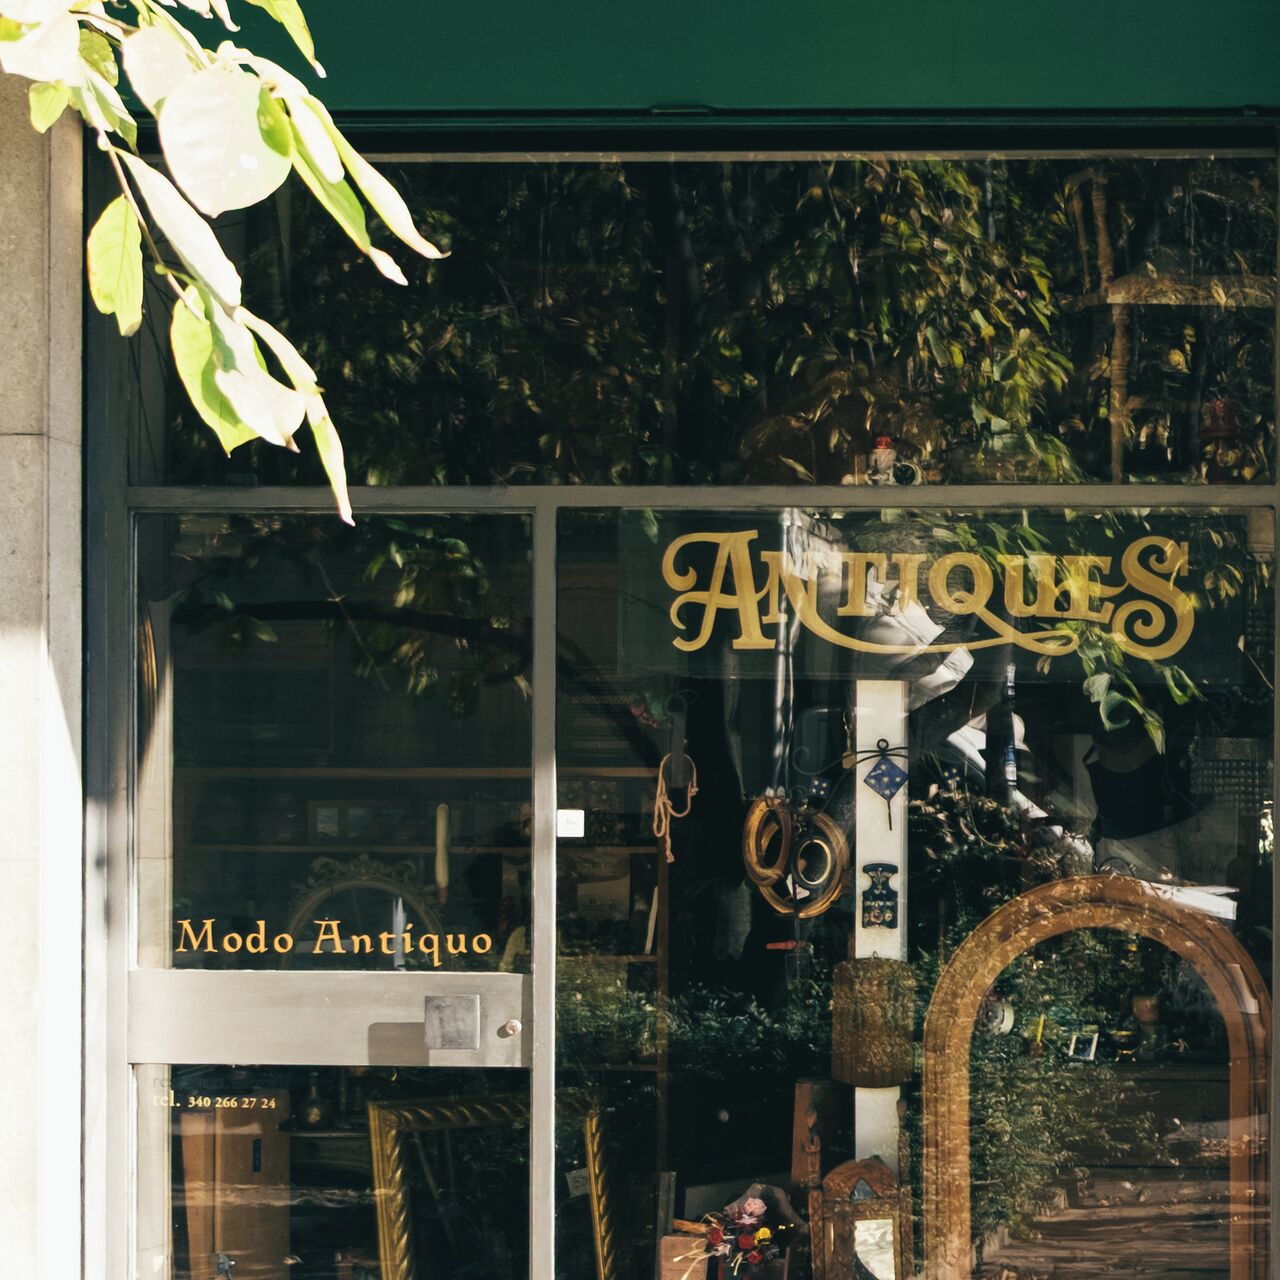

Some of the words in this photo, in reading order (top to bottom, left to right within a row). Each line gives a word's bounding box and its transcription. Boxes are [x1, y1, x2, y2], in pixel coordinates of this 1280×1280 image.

[661, 528, 1196, 660] ANTIQUES
[176, 919, 294, 953] Modo
[312, 918, 492, 967] Antiquo
[153, 1089, 181, 1108] tel.
[188, 1096, 211, 1108] 340
[215, 1096, 238, 1108] 266
[241, 1097, 257, 1109] 27
[260, 1097, 276, 1109] 24
